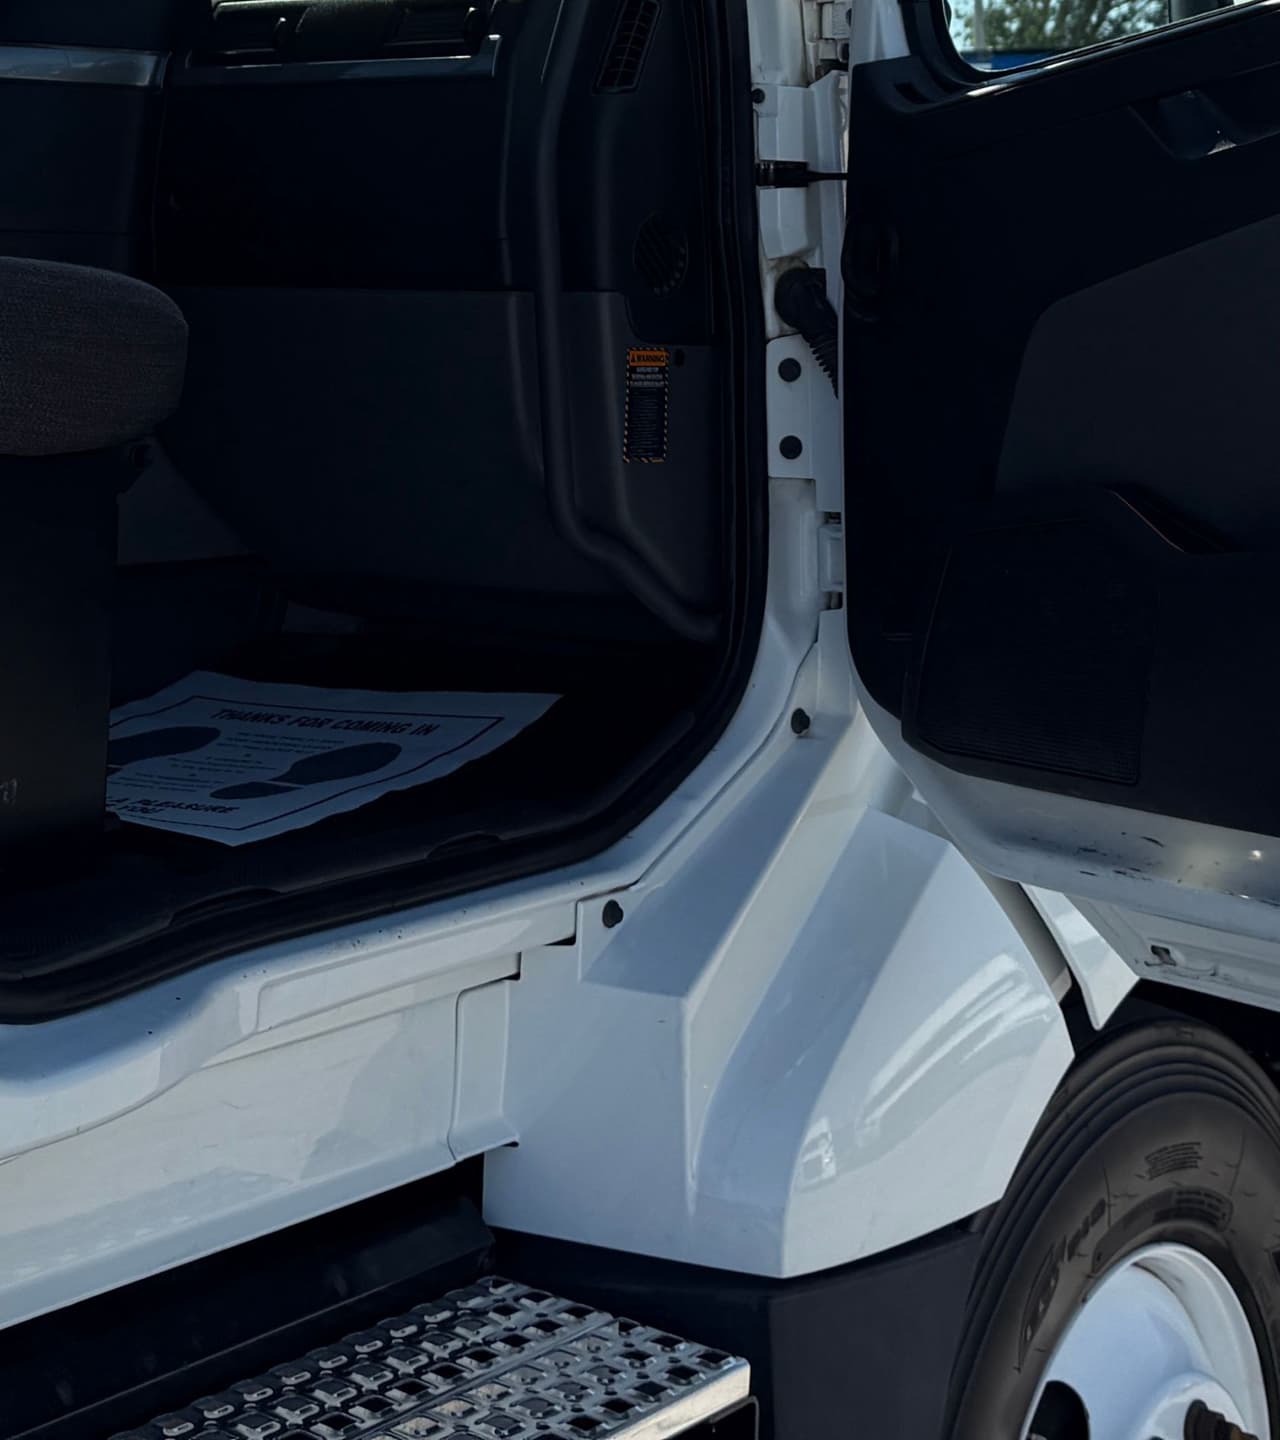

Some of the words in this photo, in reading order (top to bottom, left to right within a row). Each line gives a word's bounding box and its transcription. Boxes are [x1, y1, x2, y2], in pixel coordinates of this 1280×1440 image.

[210, 709, 290, 725] THANKS
[287, 715, 332, 729] FOR
[330, 718, 412, 734] COMING
[409, 722, 440, 736] IN
